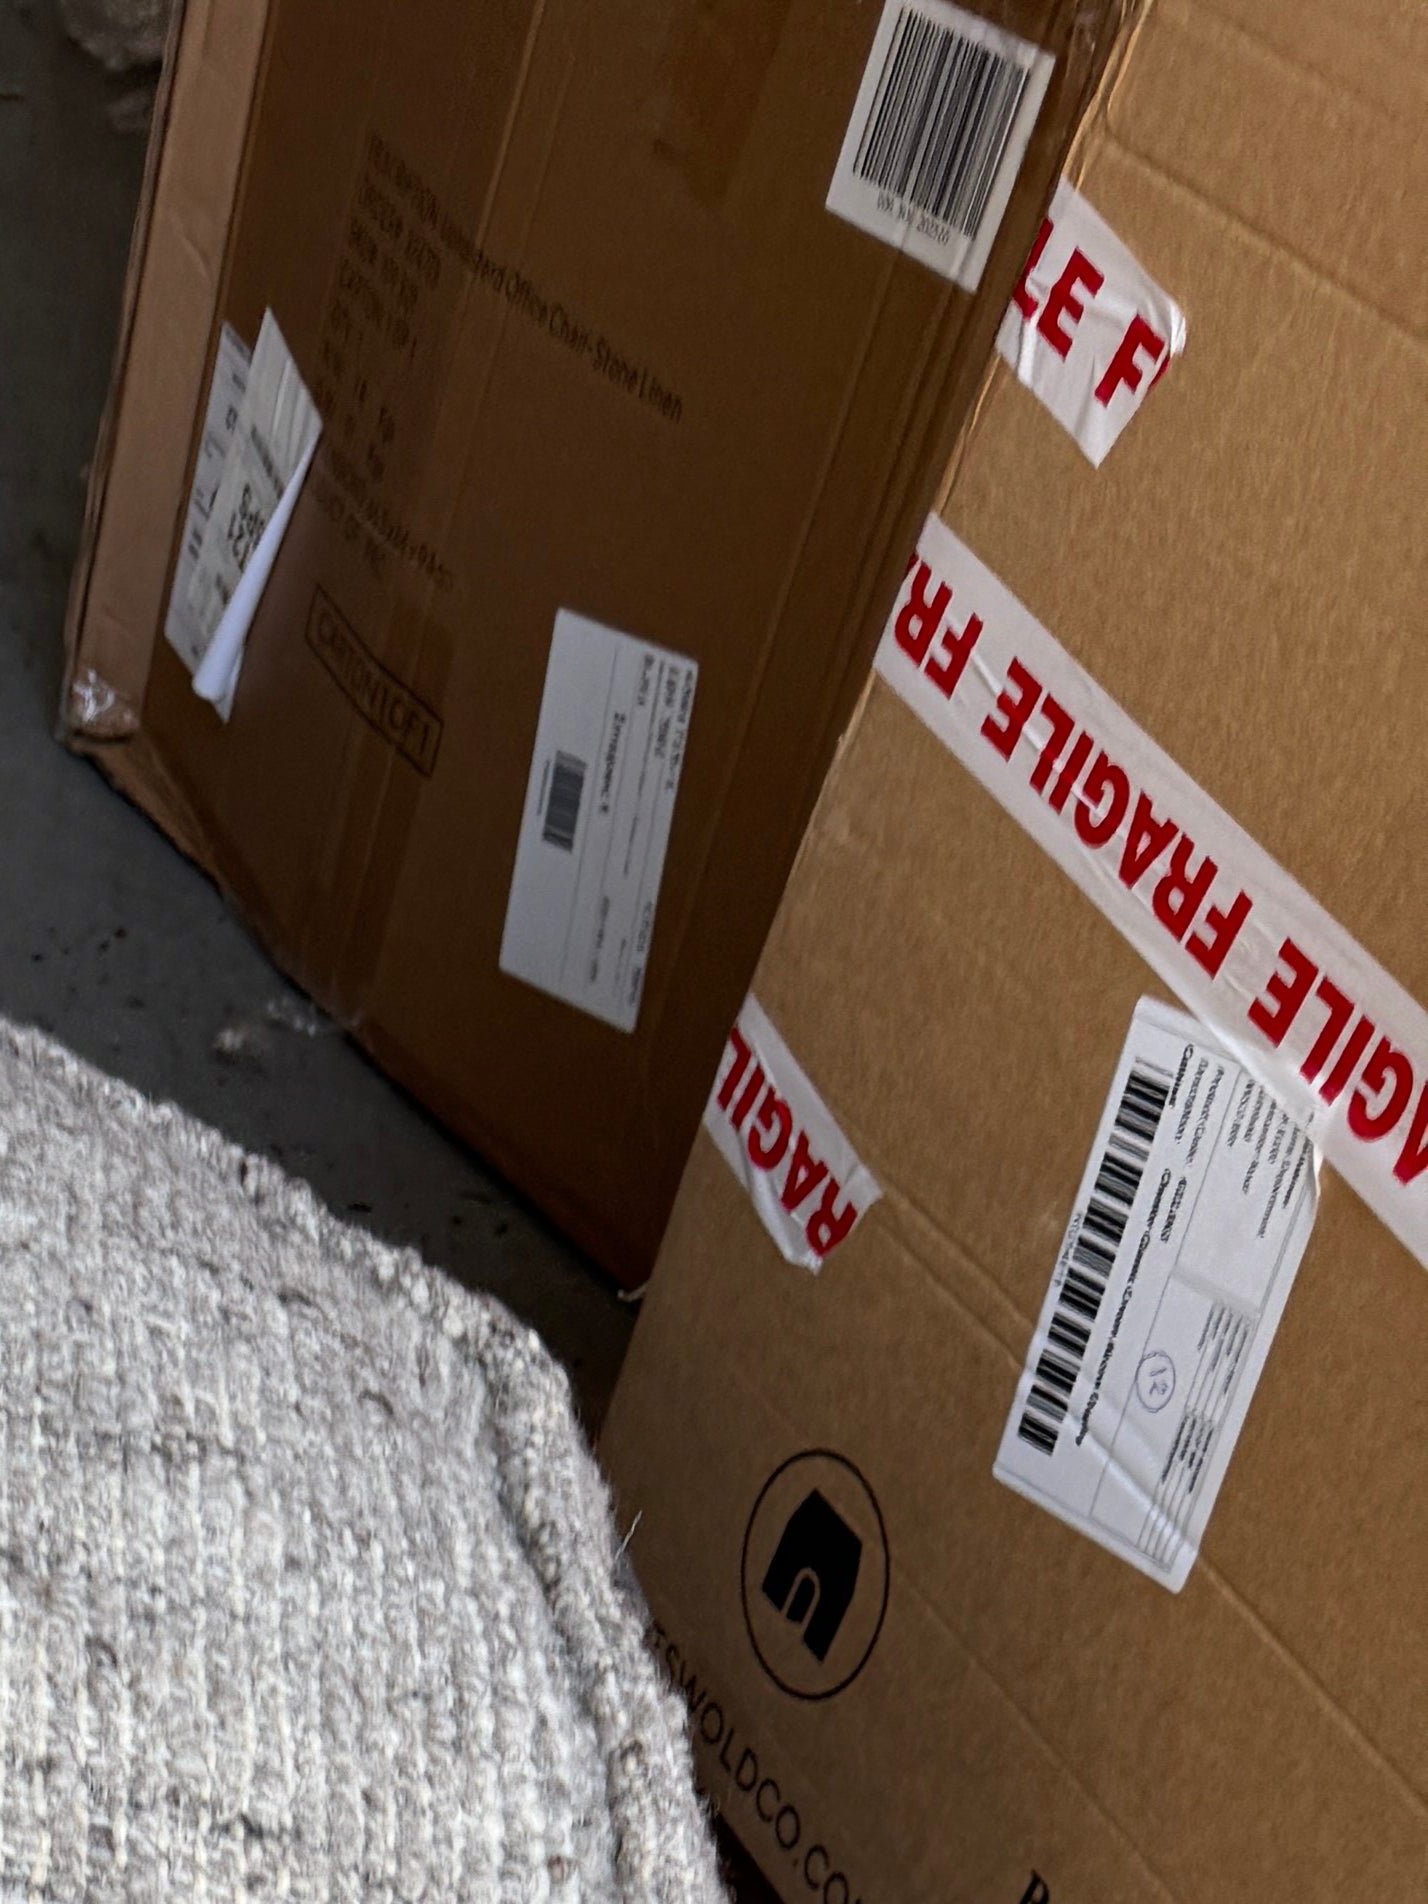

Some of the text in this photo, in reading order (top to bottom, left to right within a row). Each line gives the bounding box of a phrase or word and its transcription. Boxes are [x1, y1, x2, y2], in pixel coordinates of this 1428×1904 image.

[1094, 313, 1171, 409] F
[894, 551, 984, 700] FR
[980, 656, 1253, 980] FRAGILE
[716, 1023, 857, 1258] RAGIL
